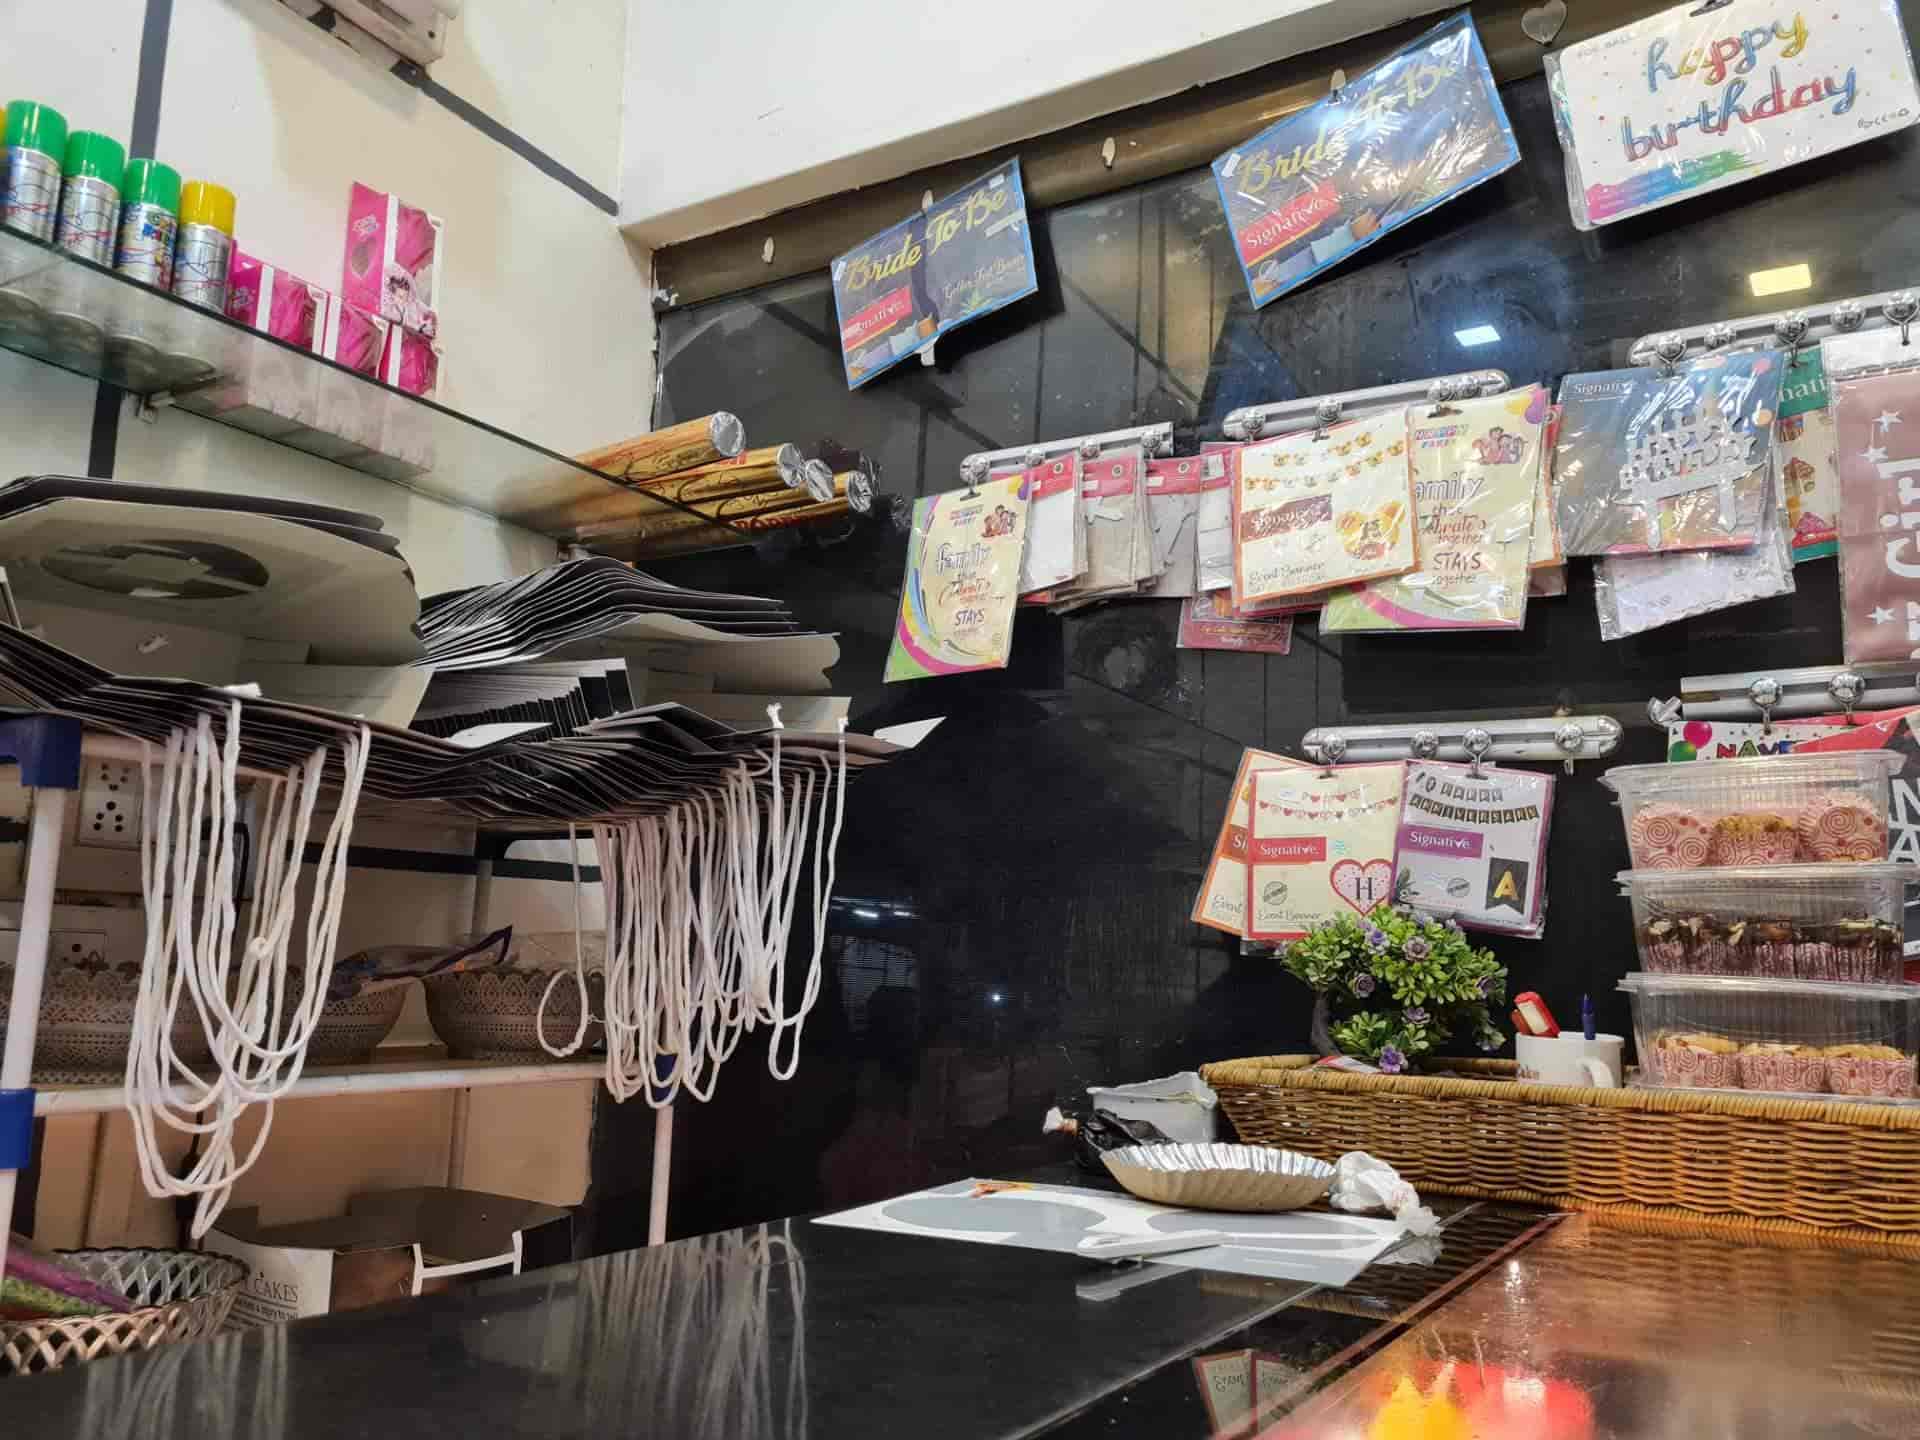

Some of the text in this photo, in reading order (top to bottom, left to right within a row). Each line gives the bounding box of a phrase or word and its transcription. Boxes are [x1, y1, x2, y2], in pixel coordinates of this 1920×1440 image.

[1648, 12, 1808, 92] happy
[1621, 65, 1857, 162] birthday
[1241, 126, 1347, 193] Brid
[846, 232, 923, 290] Bride
[925, 208, 962, 256] To
[963, 189, 1008, 232] Be
[1411, 468, 1485, 503] amily
[1354, 877, 1373, 901] H
